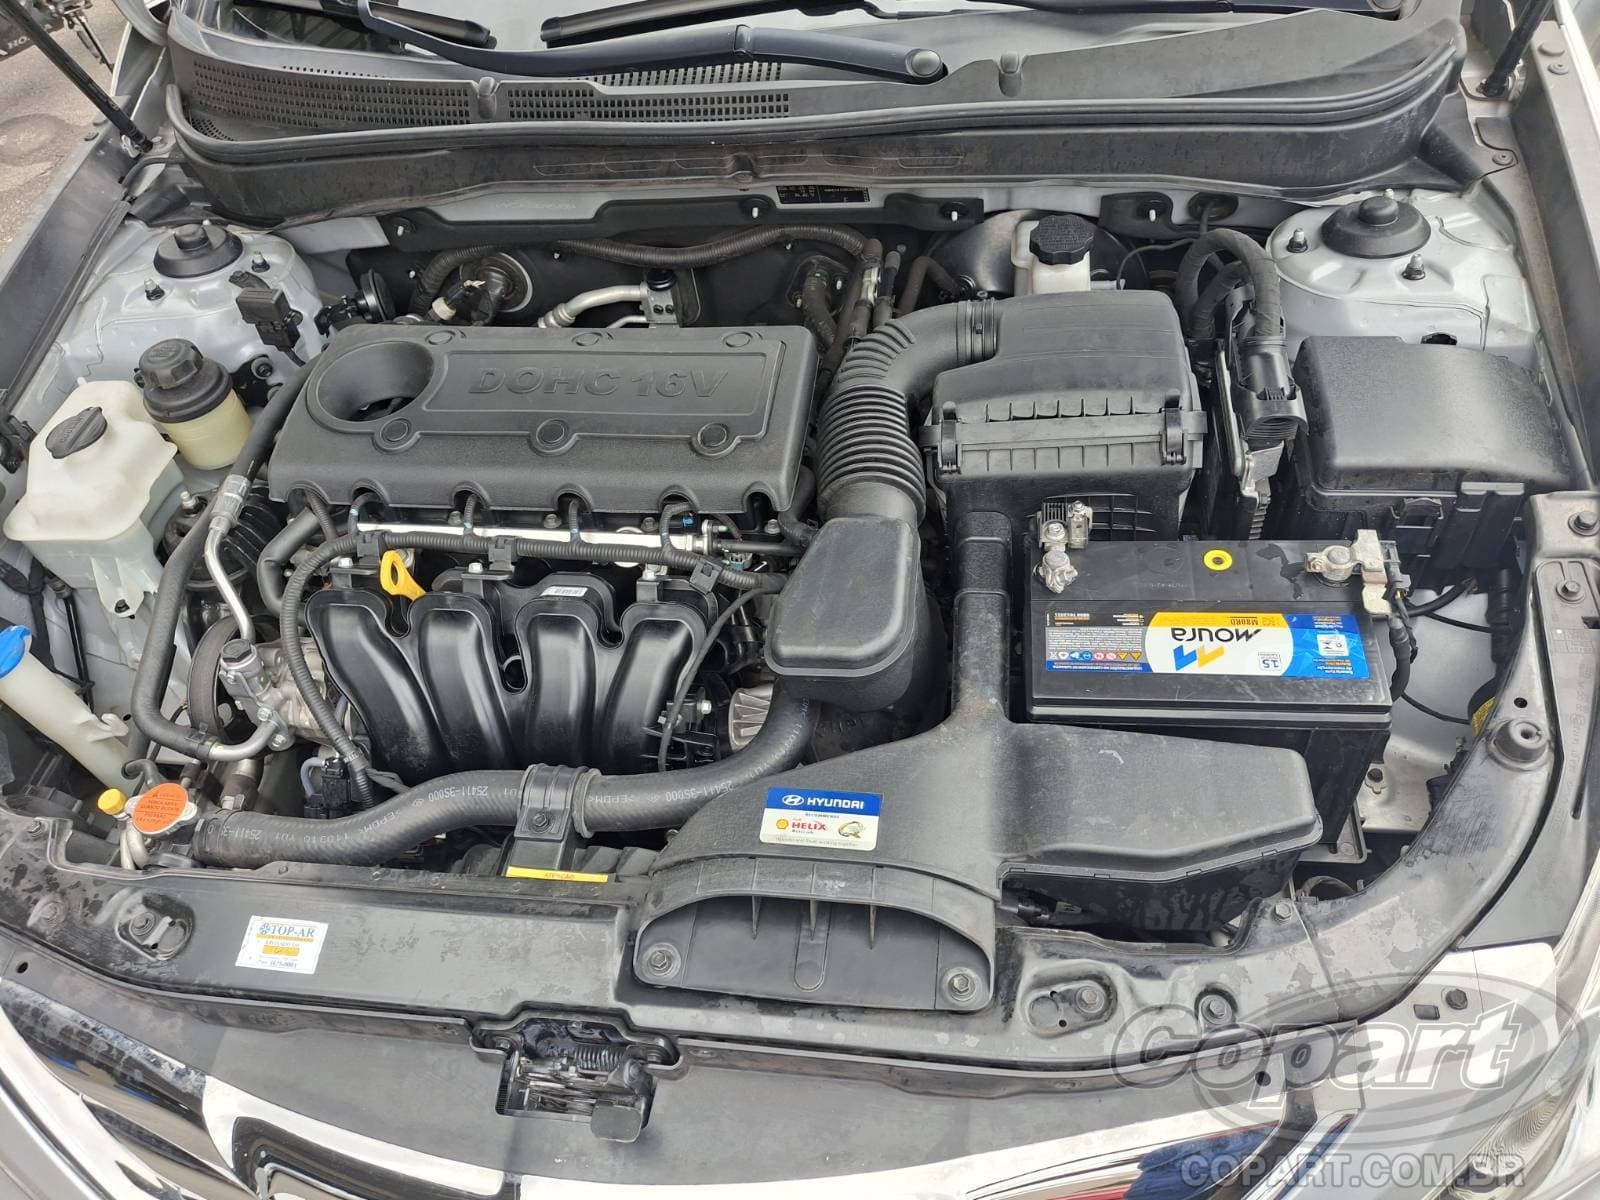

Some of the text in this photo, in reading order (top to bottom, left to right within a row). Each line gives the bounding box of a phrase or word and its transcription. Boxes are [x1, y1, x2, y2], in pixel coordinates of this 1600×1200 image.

[468, 367, 728, 397] DOHC 16V
[1262, 659, 1279, 669] 15
[428, 785, 489, 804] 25411-3S000
[807, 797, 864, 809] HYUNDAI
[791, 820, 828, 831] HELIX
[271, 924, 316, 938] TOP-AR
